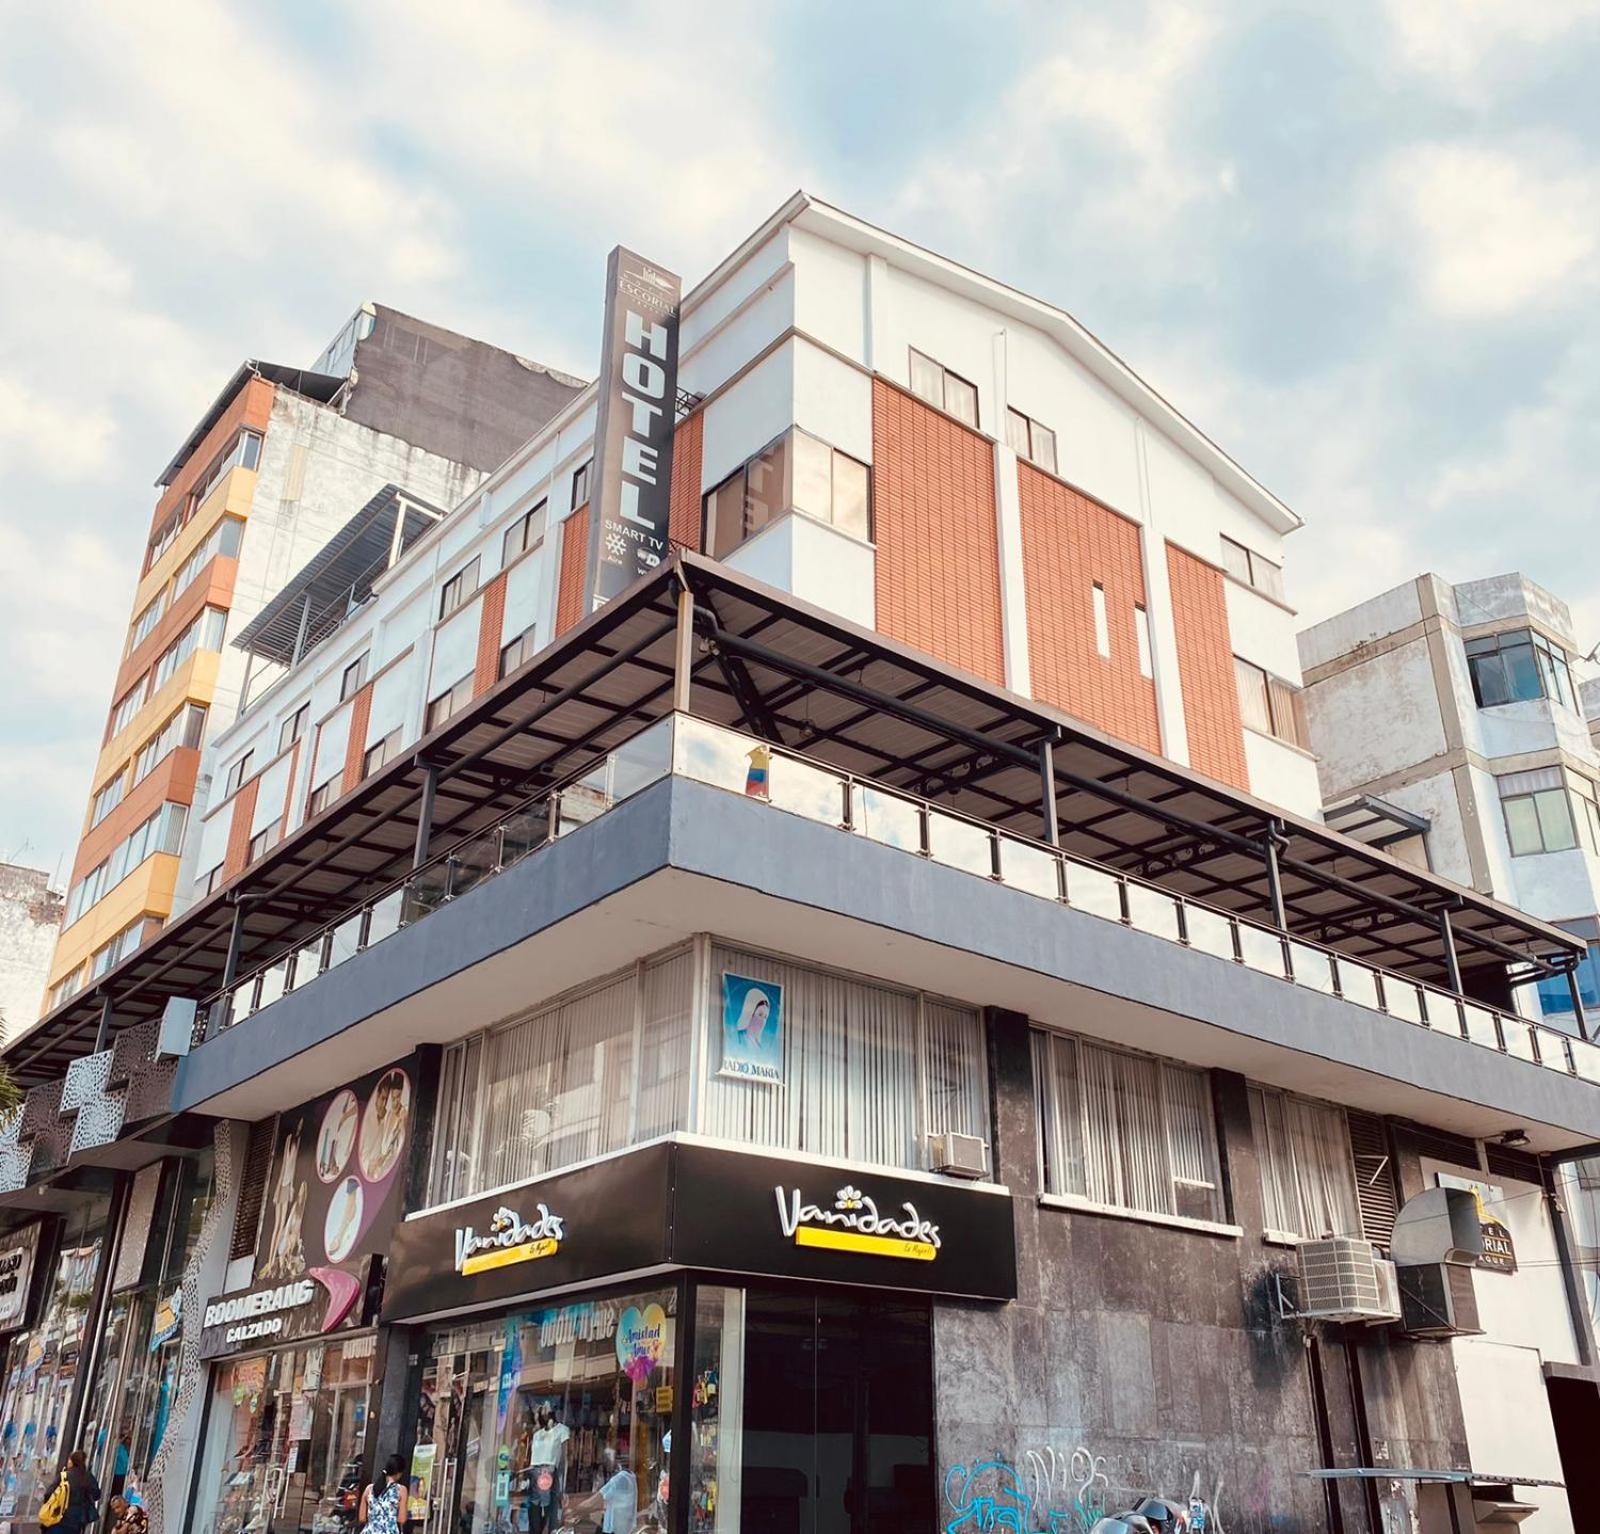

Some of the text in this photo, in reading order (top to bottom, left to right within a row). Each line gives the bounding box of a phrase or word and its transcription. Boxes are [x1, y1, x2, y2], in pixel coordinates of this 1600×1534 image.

[619, 309, 668, 530] HOTEL
[604, 519, 663, 550] SMART TV
[775, 1185, 941, 1248] Vanidades
[1482, 1238, 1512, 1255] RIAL
[203, 1279, 315, 1328] BOOMERANG
[226, 1318, 282, 1343] CALZADO
